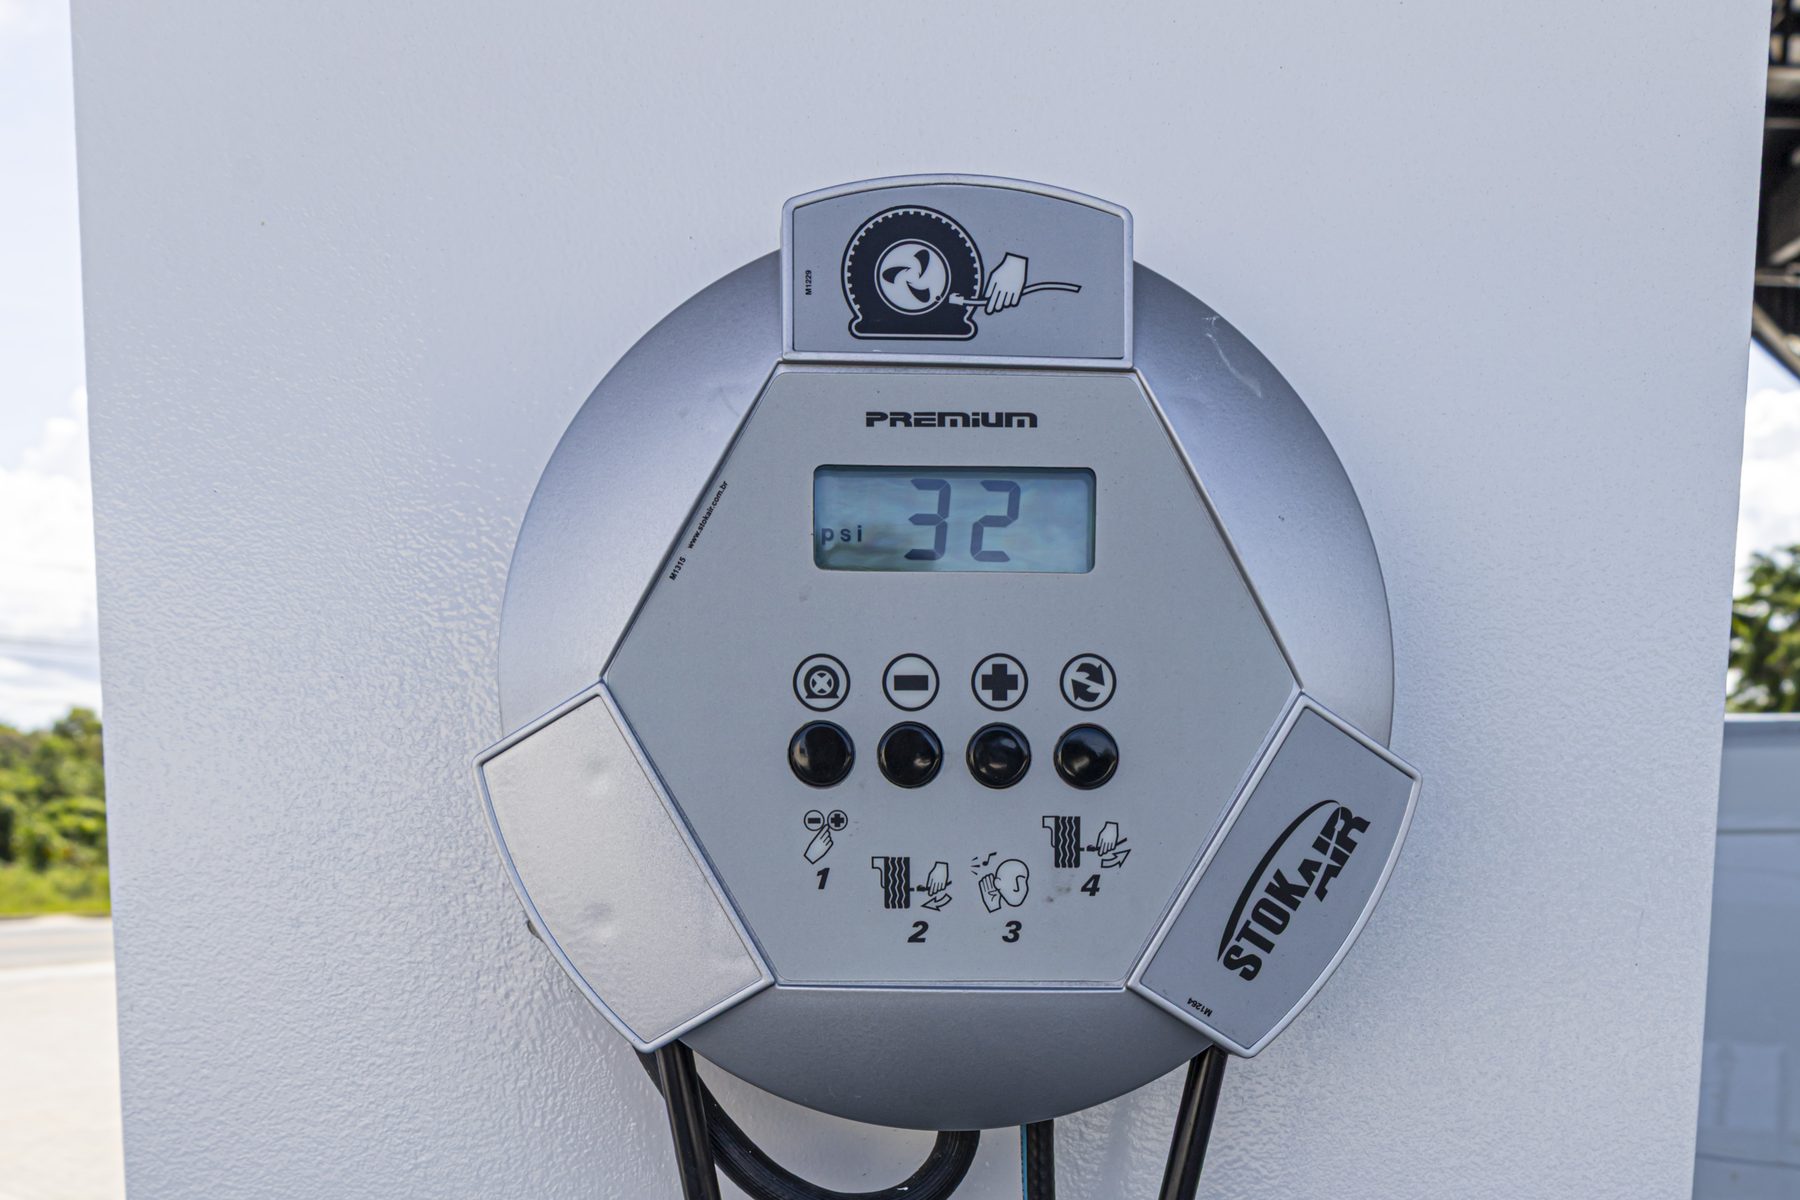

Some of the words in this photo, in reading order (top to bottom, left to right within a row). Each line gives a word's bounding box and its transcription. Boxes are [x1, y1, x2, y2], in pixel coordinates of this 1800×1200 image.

[804, 269, 813, 296] M1229
[904, 477, 1022, 563] 32
[820, 524, 863, 548] psi
[816, 867, 831, 890] 1
[1080, 873, 1102, 897] 4
[1222, 805, 1372, 982] STOKAIR
[907, 920, 930, 943] 2
[1001, 920, 1023, 943] 3
